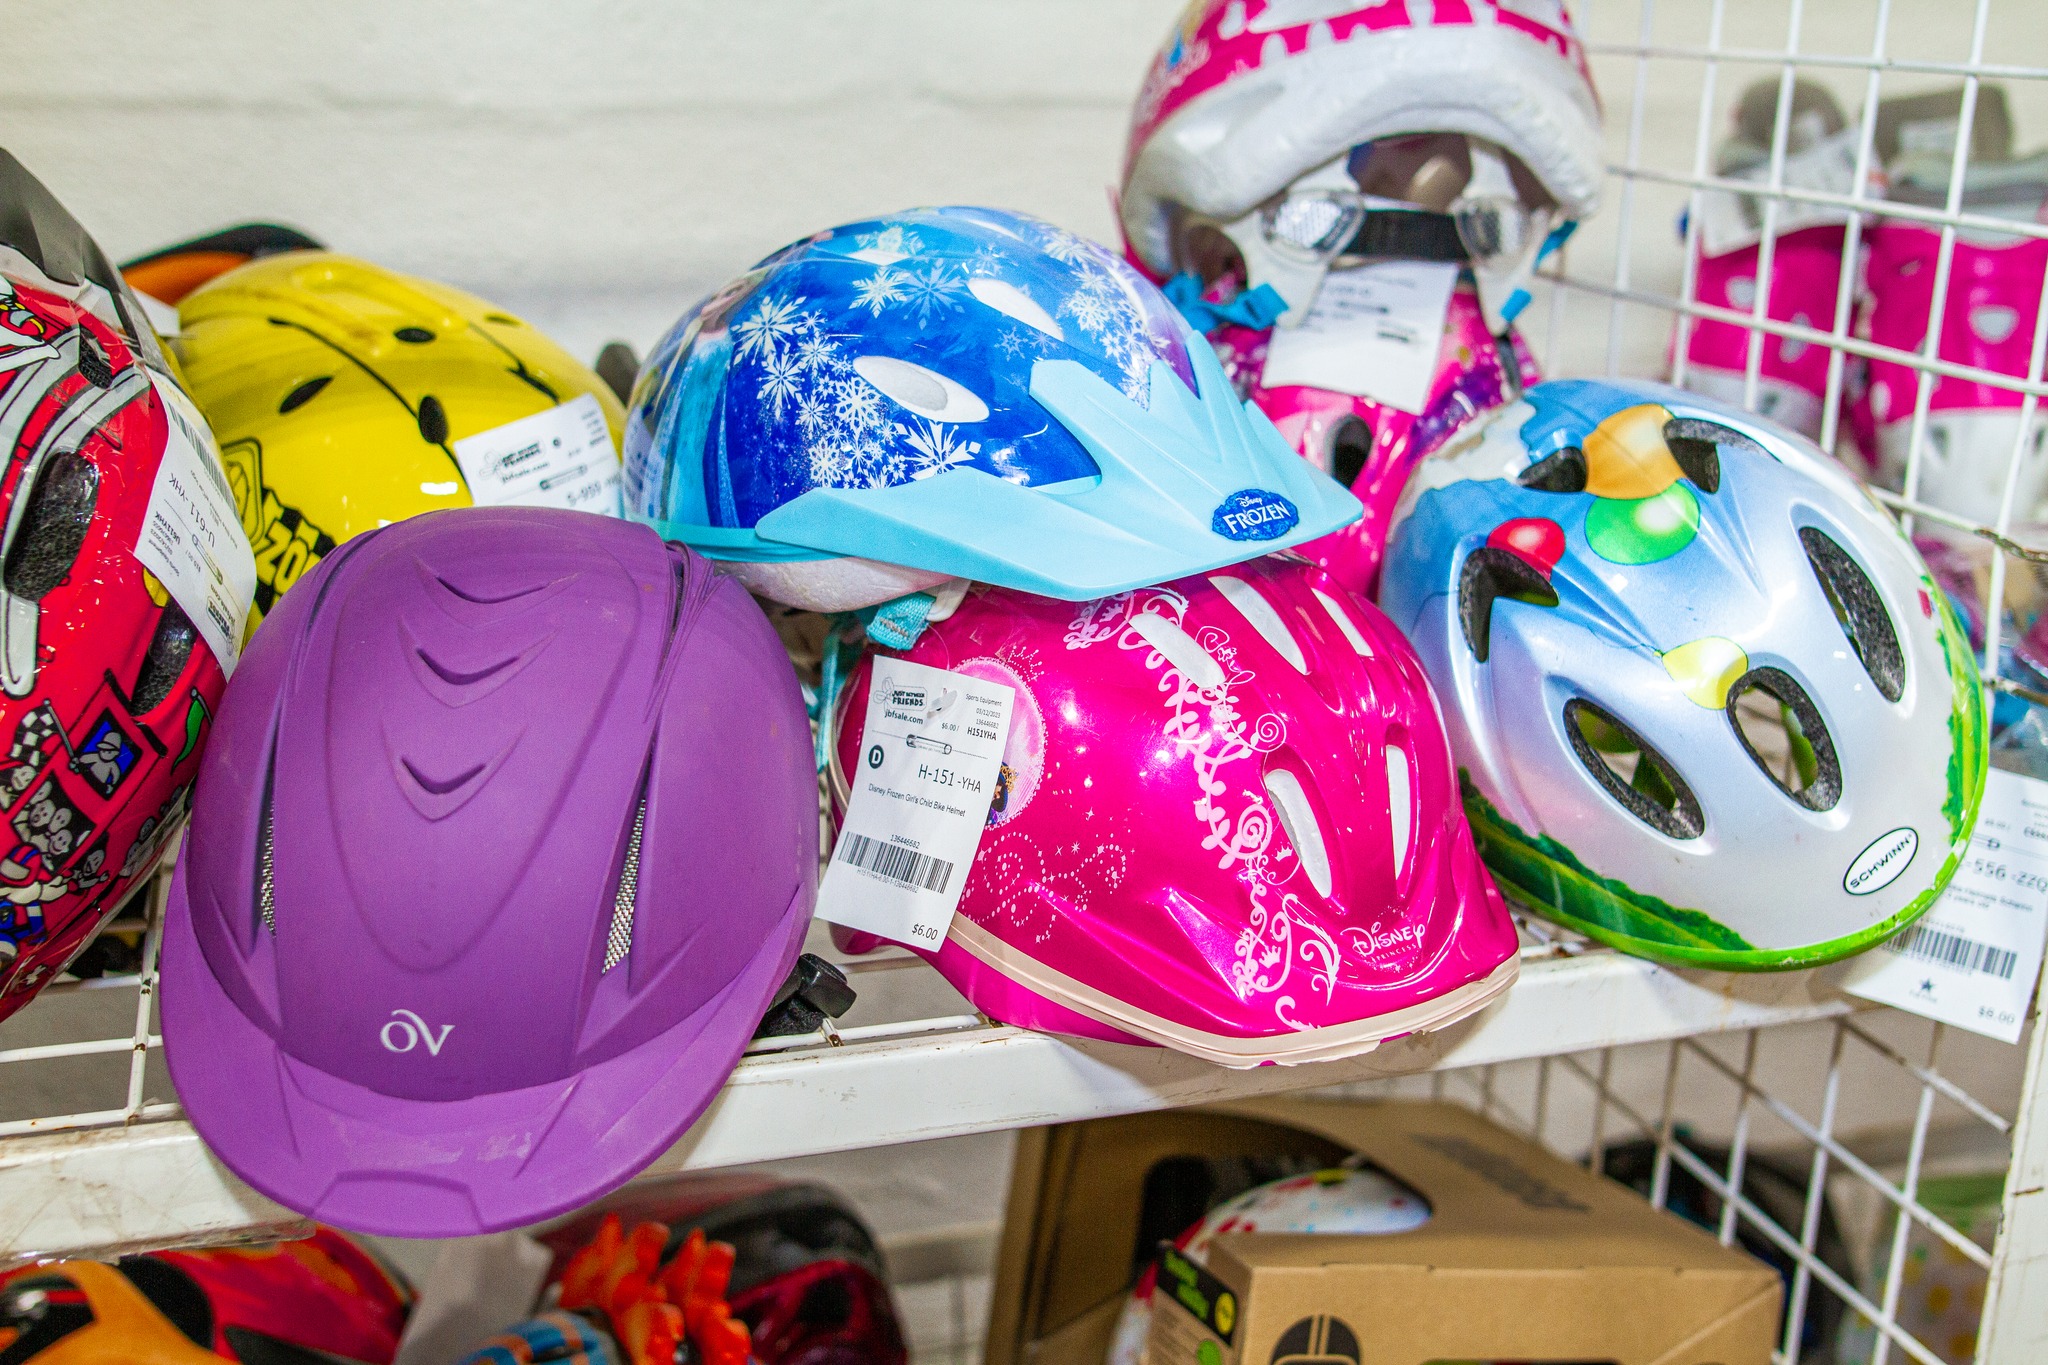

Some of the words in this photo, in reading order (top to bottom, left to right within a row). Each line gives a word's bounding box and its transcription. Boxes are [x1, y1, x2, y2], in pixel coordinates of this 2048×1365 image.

[190, 501, 215, 548] U-611
[1222, 501, 1292, 535] FROZEN
[892, 697, 924, 707] FRIENDS
[965, 693, 979, 703] Sports
[979, 696, 1003, 707] Equipment
[884, 708, 924, 724] jbfsale.com
[941, 722, 957, 732] $6.00
[966, 726, 997, 741] H151YHA
[918, 763, 955, 787] H-151
[957, 776, 982, 793] -YHA
[868, 783, 887, 797] Disney
[886, 788, 905, 800] Frozen
[905, 793, 919, 804] Girl's
[919, 797, 933, 808] Child
[933, 801, 945, 812] Bike
[945, 804, 966, 817] Helmet
[1850, 836, 1910, 888] SCHWINN
[911, 922, 939, 941] $6.00
